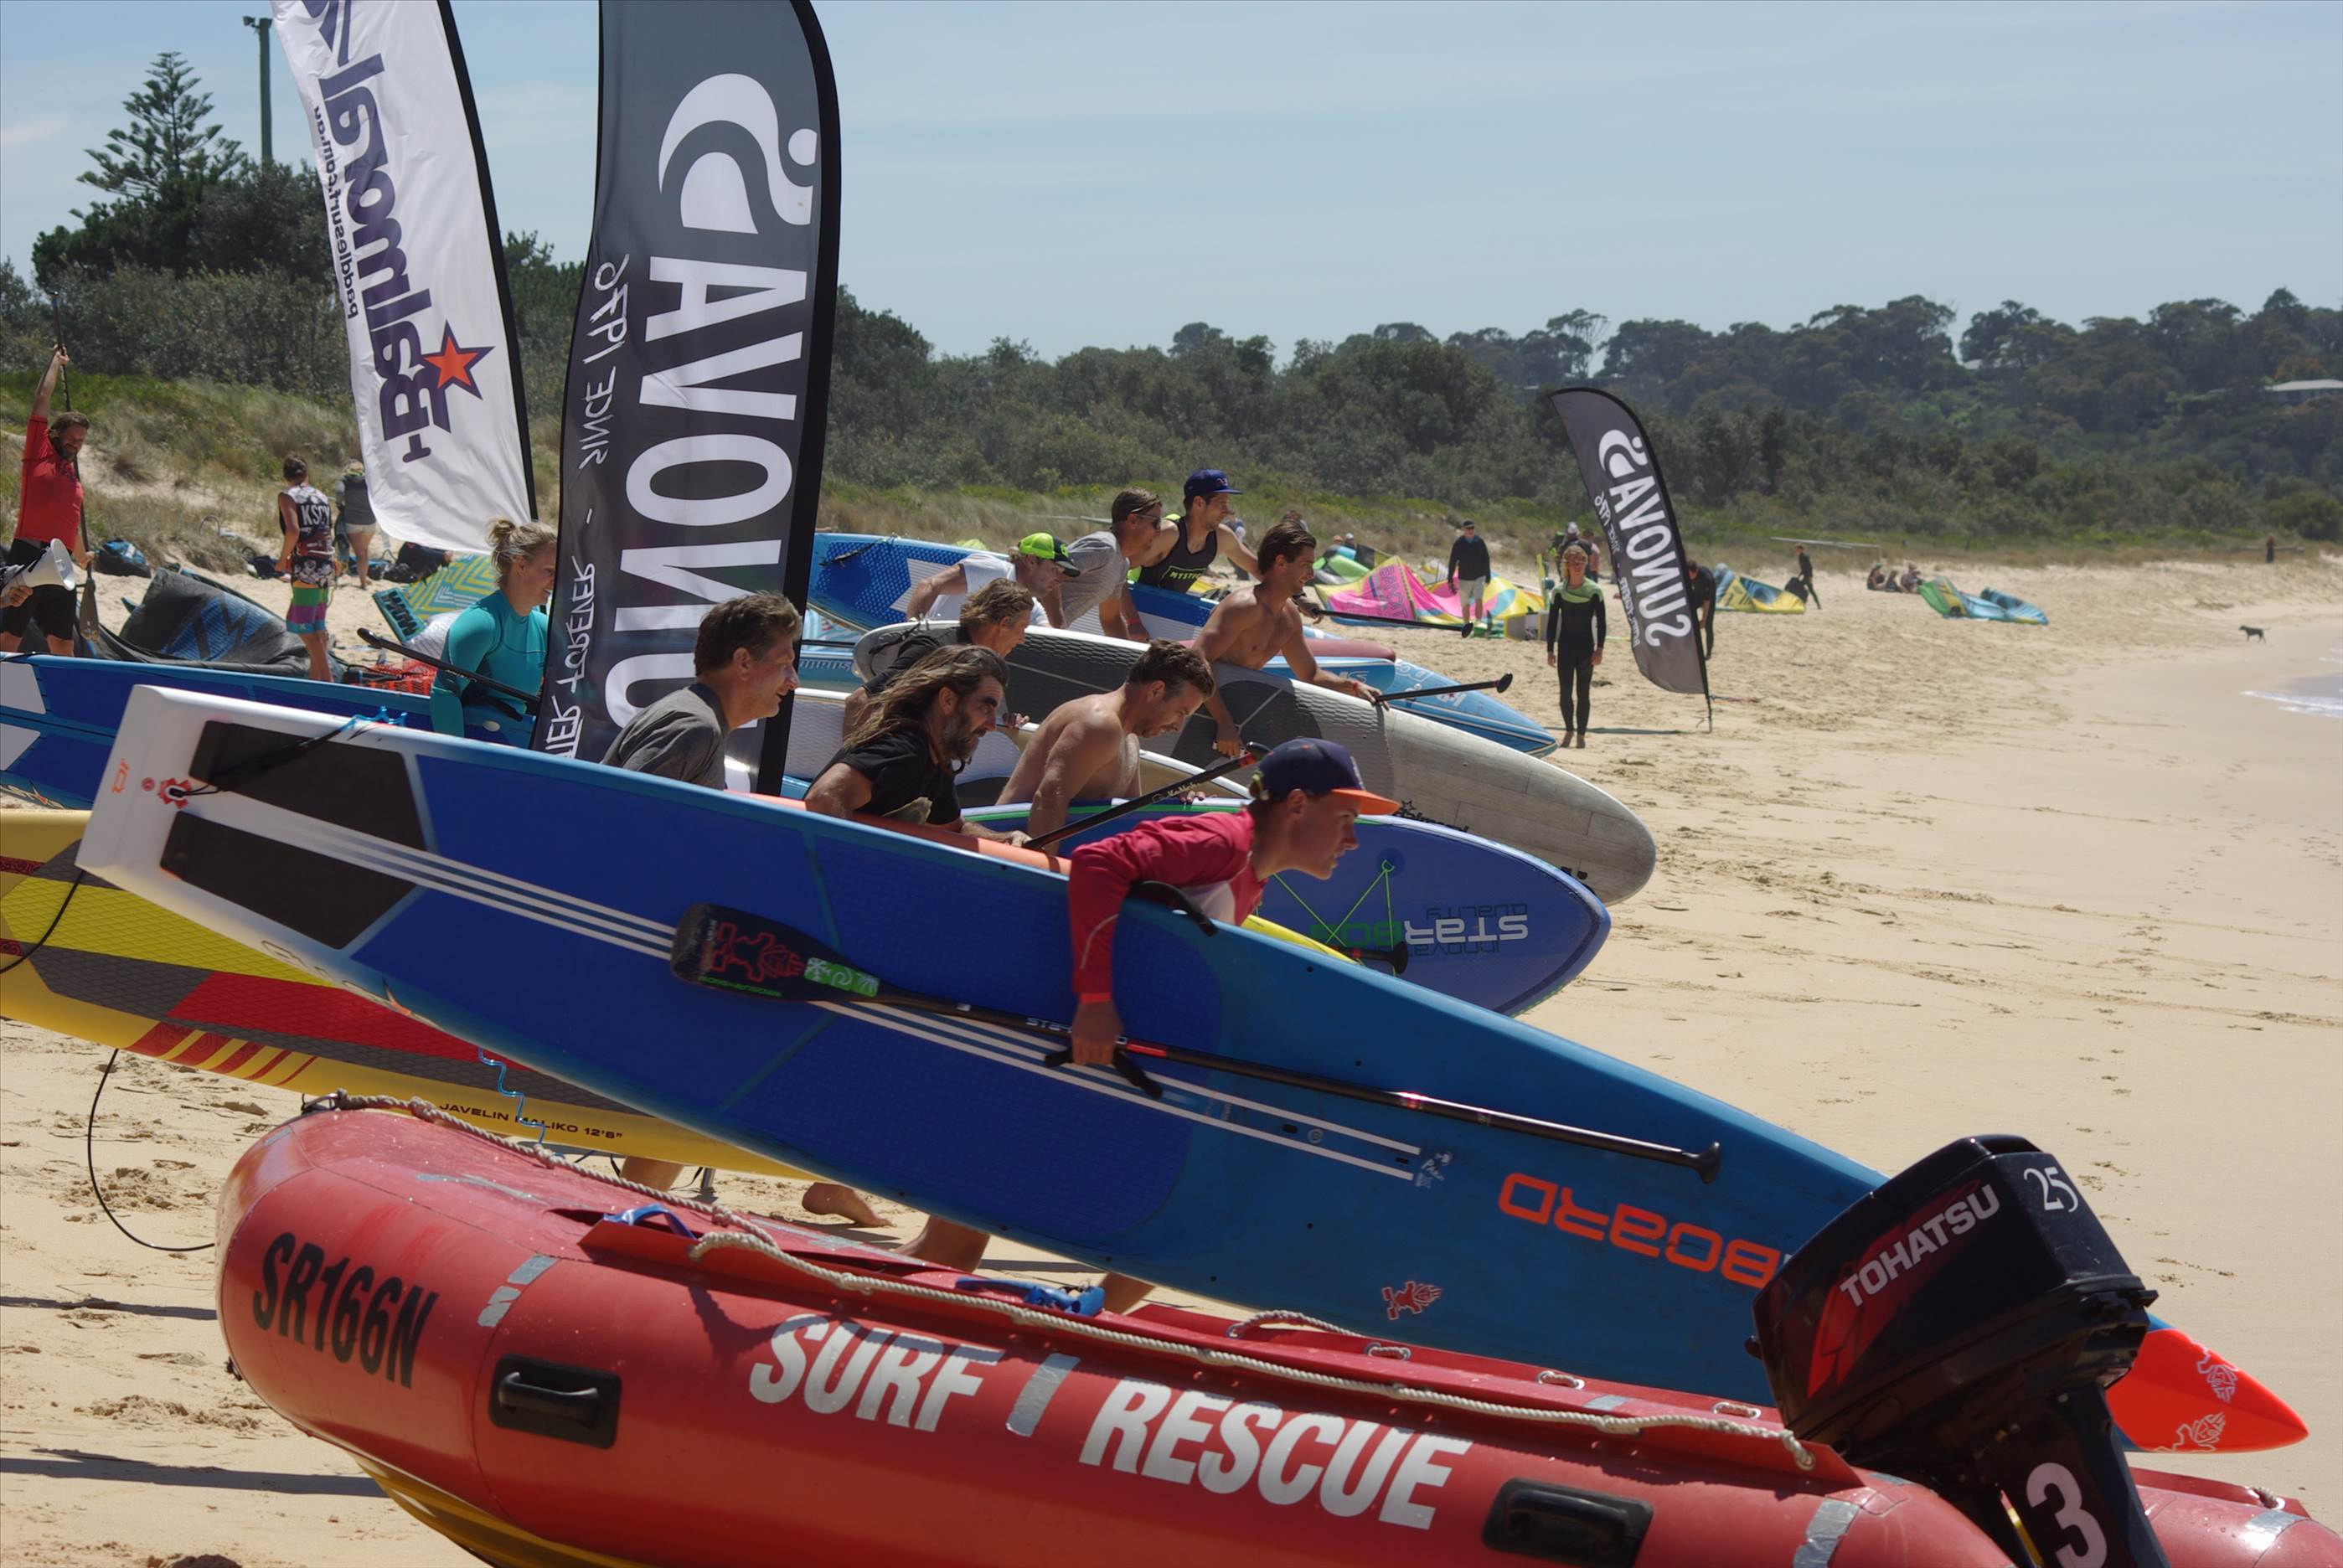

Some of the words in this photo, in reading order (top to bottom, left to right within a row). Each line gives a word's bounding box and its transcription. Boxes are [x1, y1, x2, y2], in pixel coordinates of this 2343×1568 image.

[439, 1103, 508, 1122] JAVELIN
[1840, 1184, 2001, 1308] TOHATSU
[2024, 1166, 2079, 1213] 25
[253, 1232, 438, 1390] SR166N
[750, 1313, 1006, 1433] SURF
[1079, 1375, 1474, 1531] RESCUE
[2026, 1462, 2108, 1568] 3
